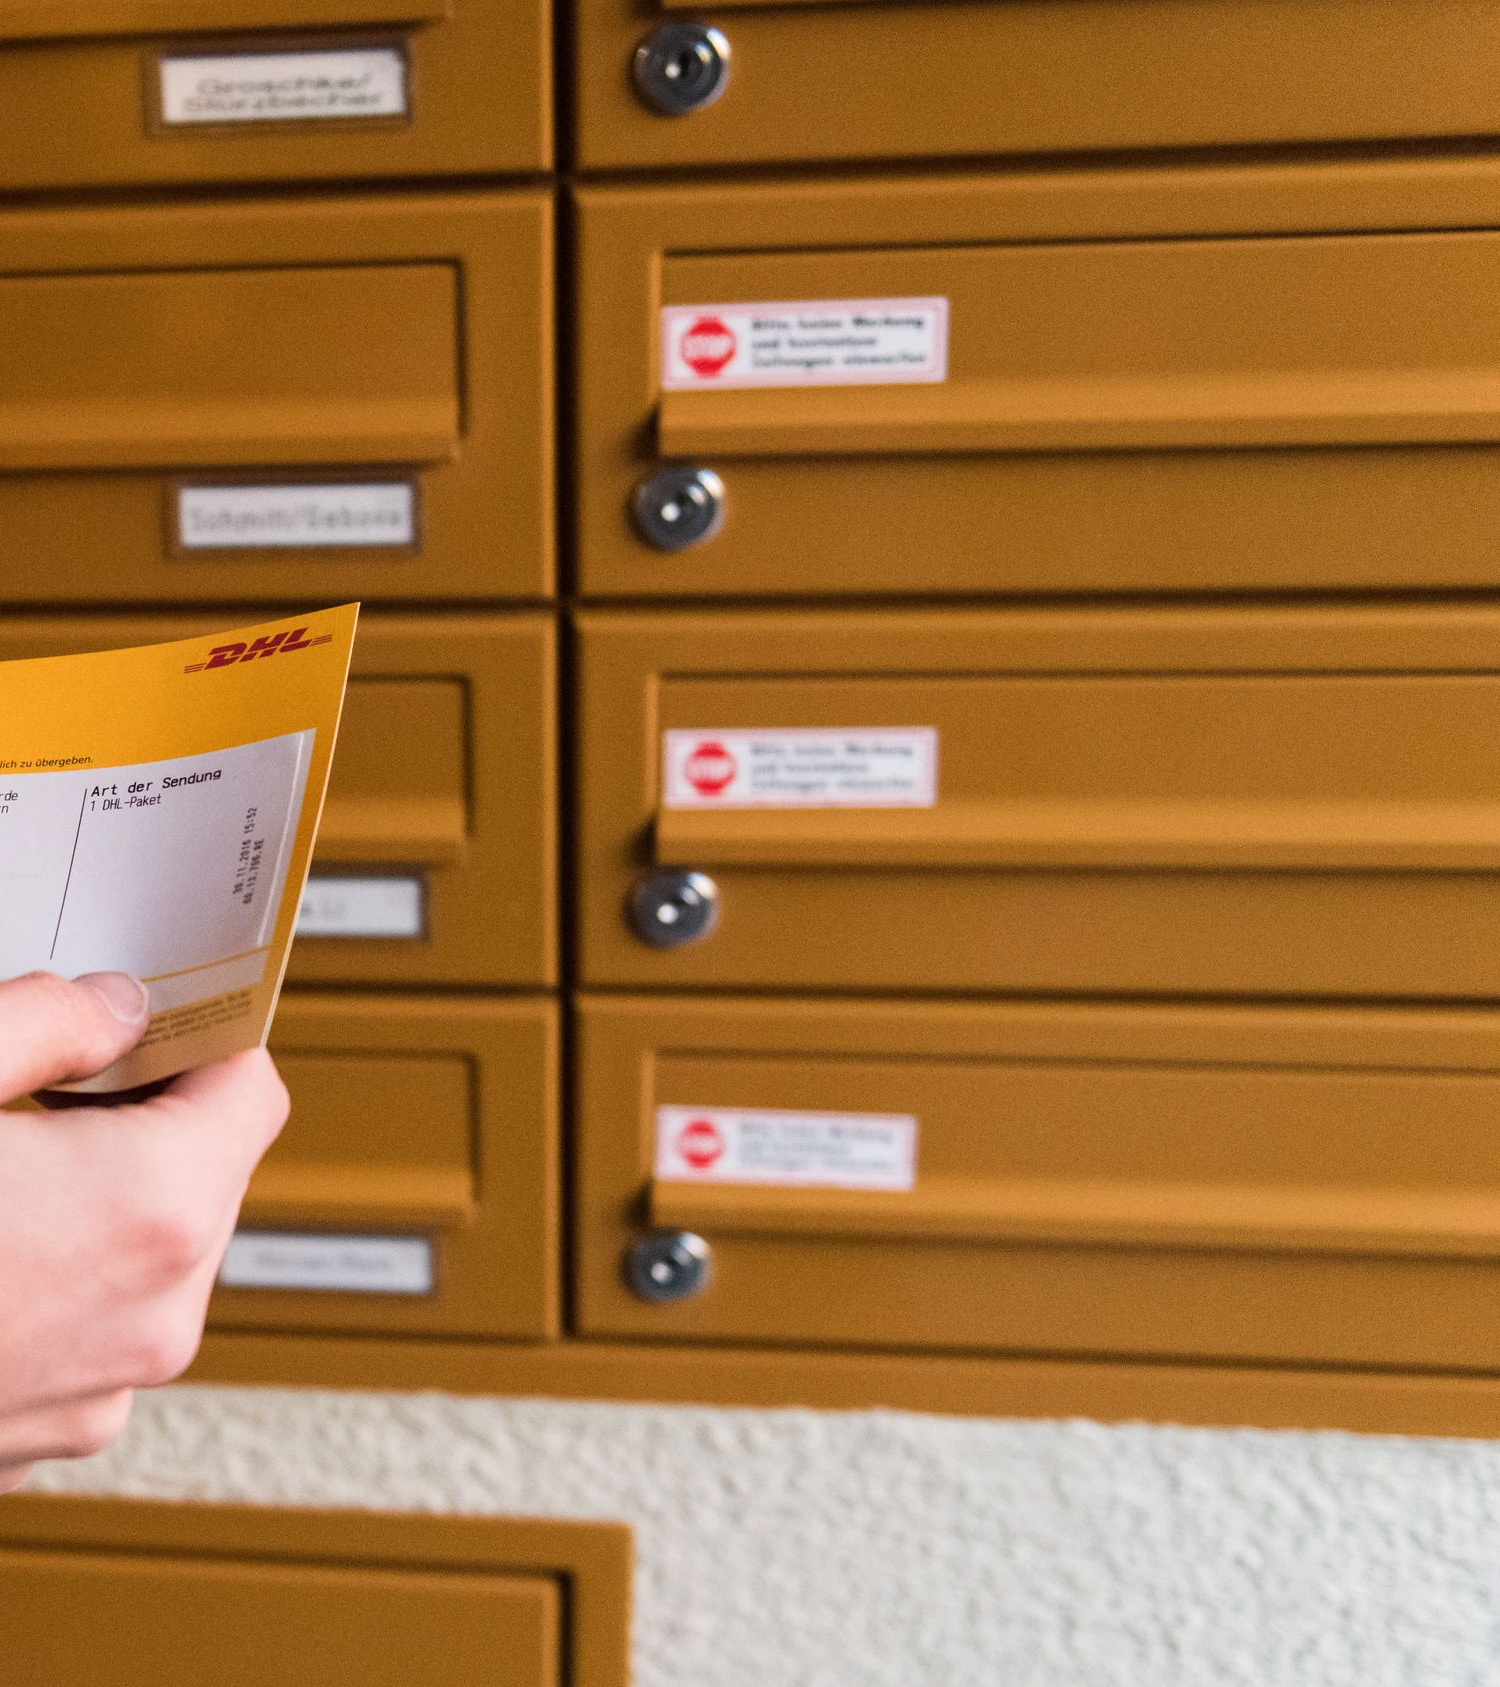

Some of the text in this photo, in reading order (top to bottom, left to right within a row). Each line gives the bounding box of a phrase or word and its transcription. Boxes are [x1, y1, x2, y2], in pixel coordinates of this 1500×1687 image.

[204, 627, 313, 670] DHL
[19, 759, 32, 768] zu
[35, 755, 94, 768] übergeben.
[90, 769, 222, 797] Art der Sendung
[90, 793, 162, 812] 1 DHL-Paket
